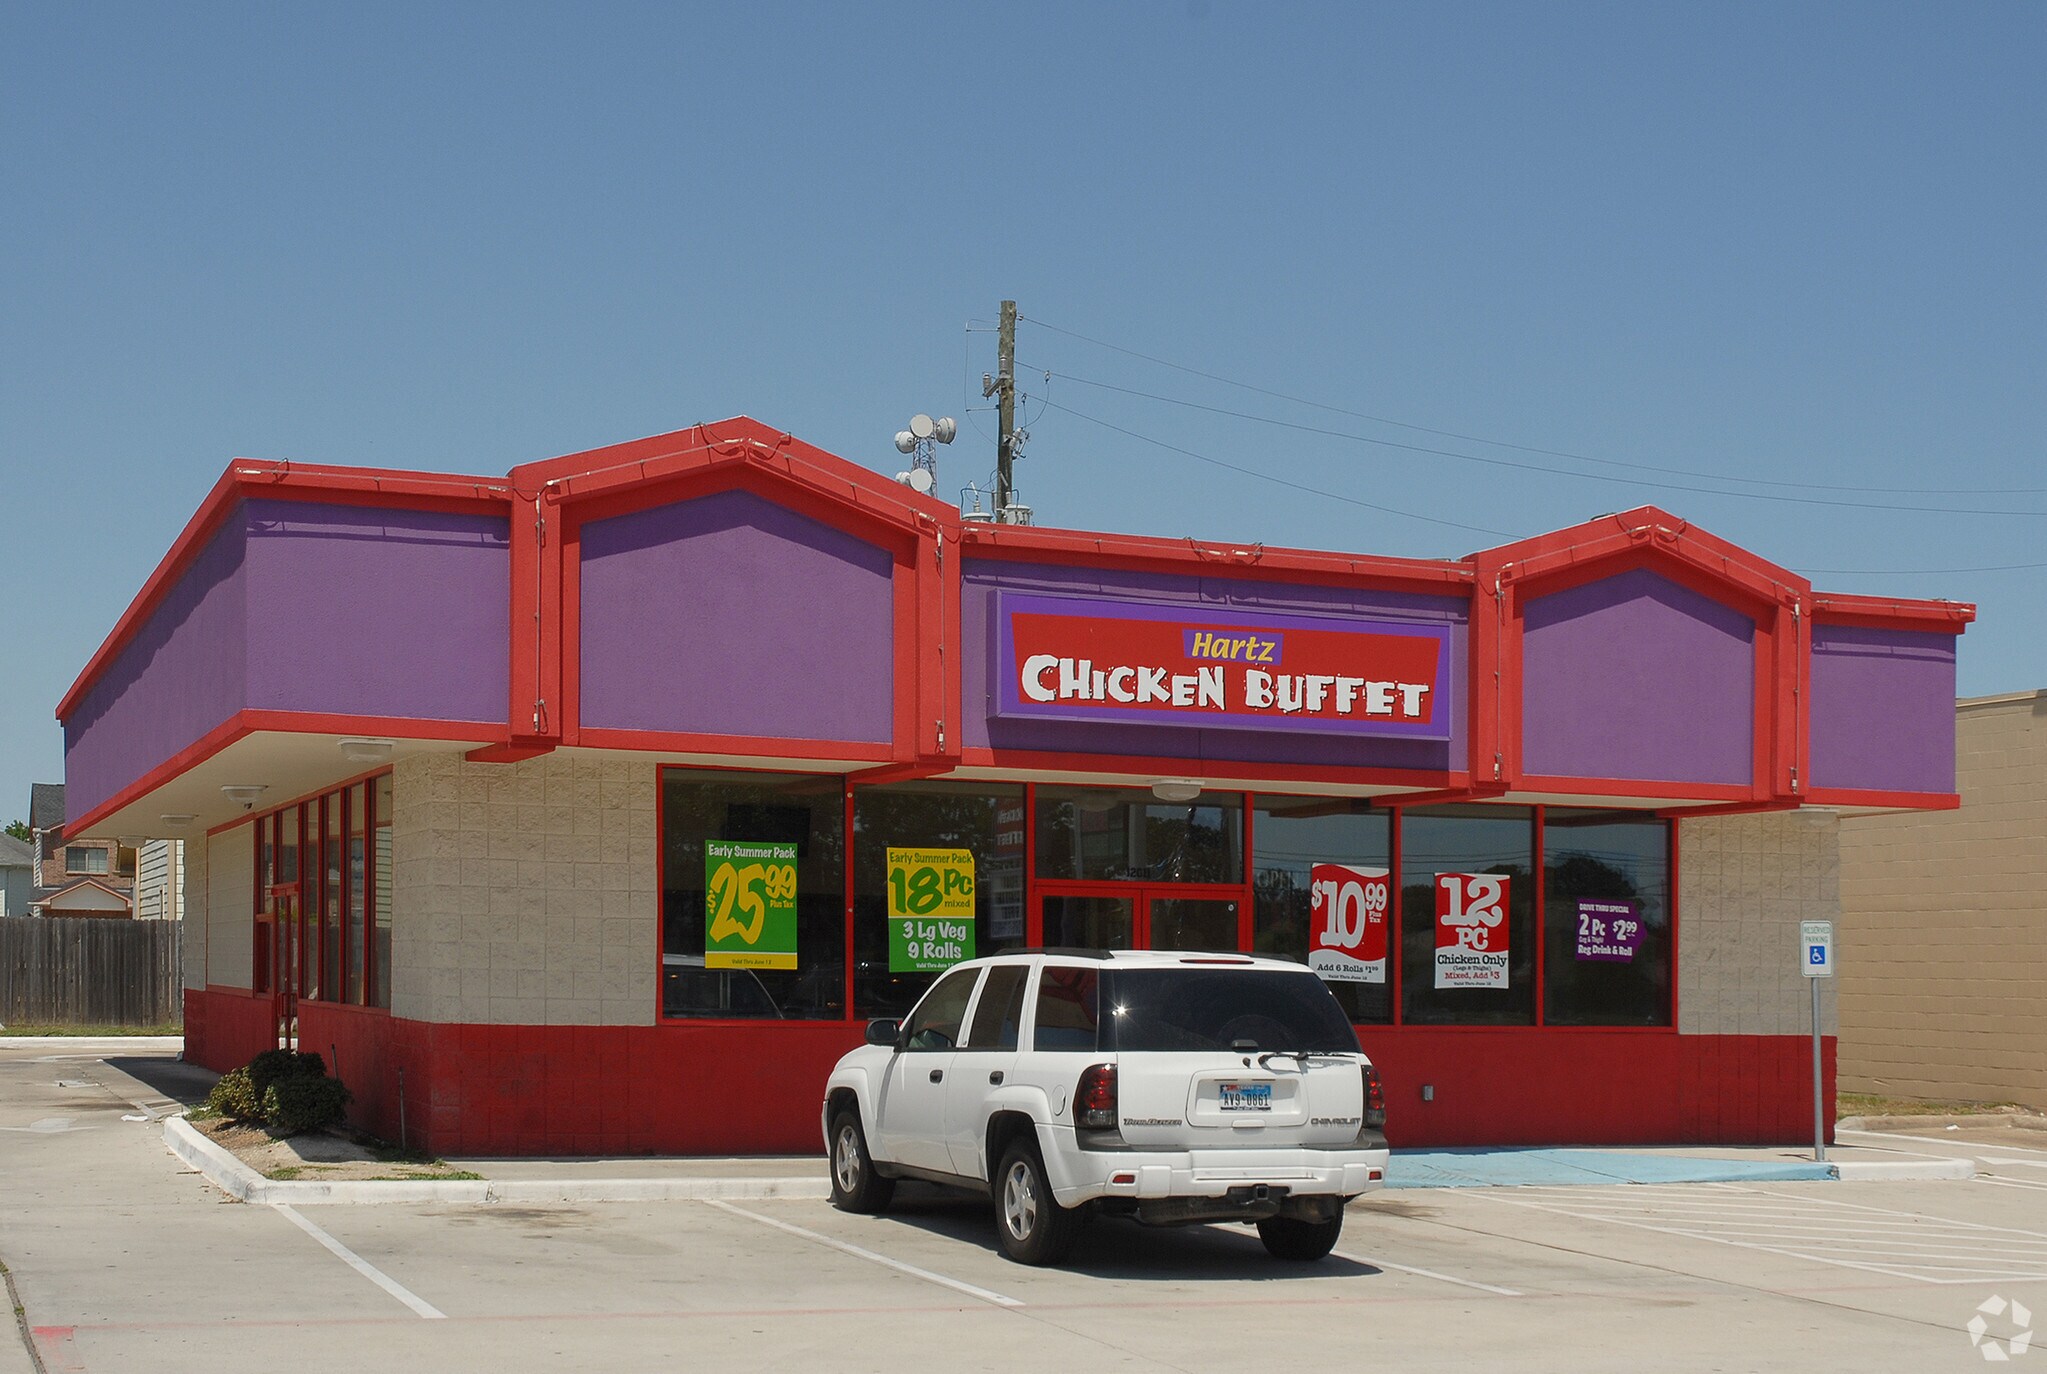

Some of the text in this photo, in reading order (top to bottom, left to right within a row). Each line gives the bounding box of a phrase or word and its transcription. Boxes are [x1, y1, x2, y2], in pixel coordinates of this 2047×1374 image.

[1191, 632, 1276, 662] Hartz
[1021, 654, 1429, 718] CHICKEN BUFFET
[708, 844, 795, 859] Early Summer Pack
[889, 852, 972, 864] Early Summer Pack
[889, 866, 943, 915] 18
[944, 900, 970, 908] mixed
[1440, 877, 1503, 927] 12
[902, 921, 966, 940] 3 Lg Veg
[1579, 914, 1606, 936] 2 Pc
[1455, 927, 1488, 950] PC
[908, 941, 962, 959] 9 Rolls
[1578, 945, 1632, 956] Reg Drink & Roll
[1343, 964, 1364, 972] Rolls
[1438, 954, 1507, 967] Chicken Only
